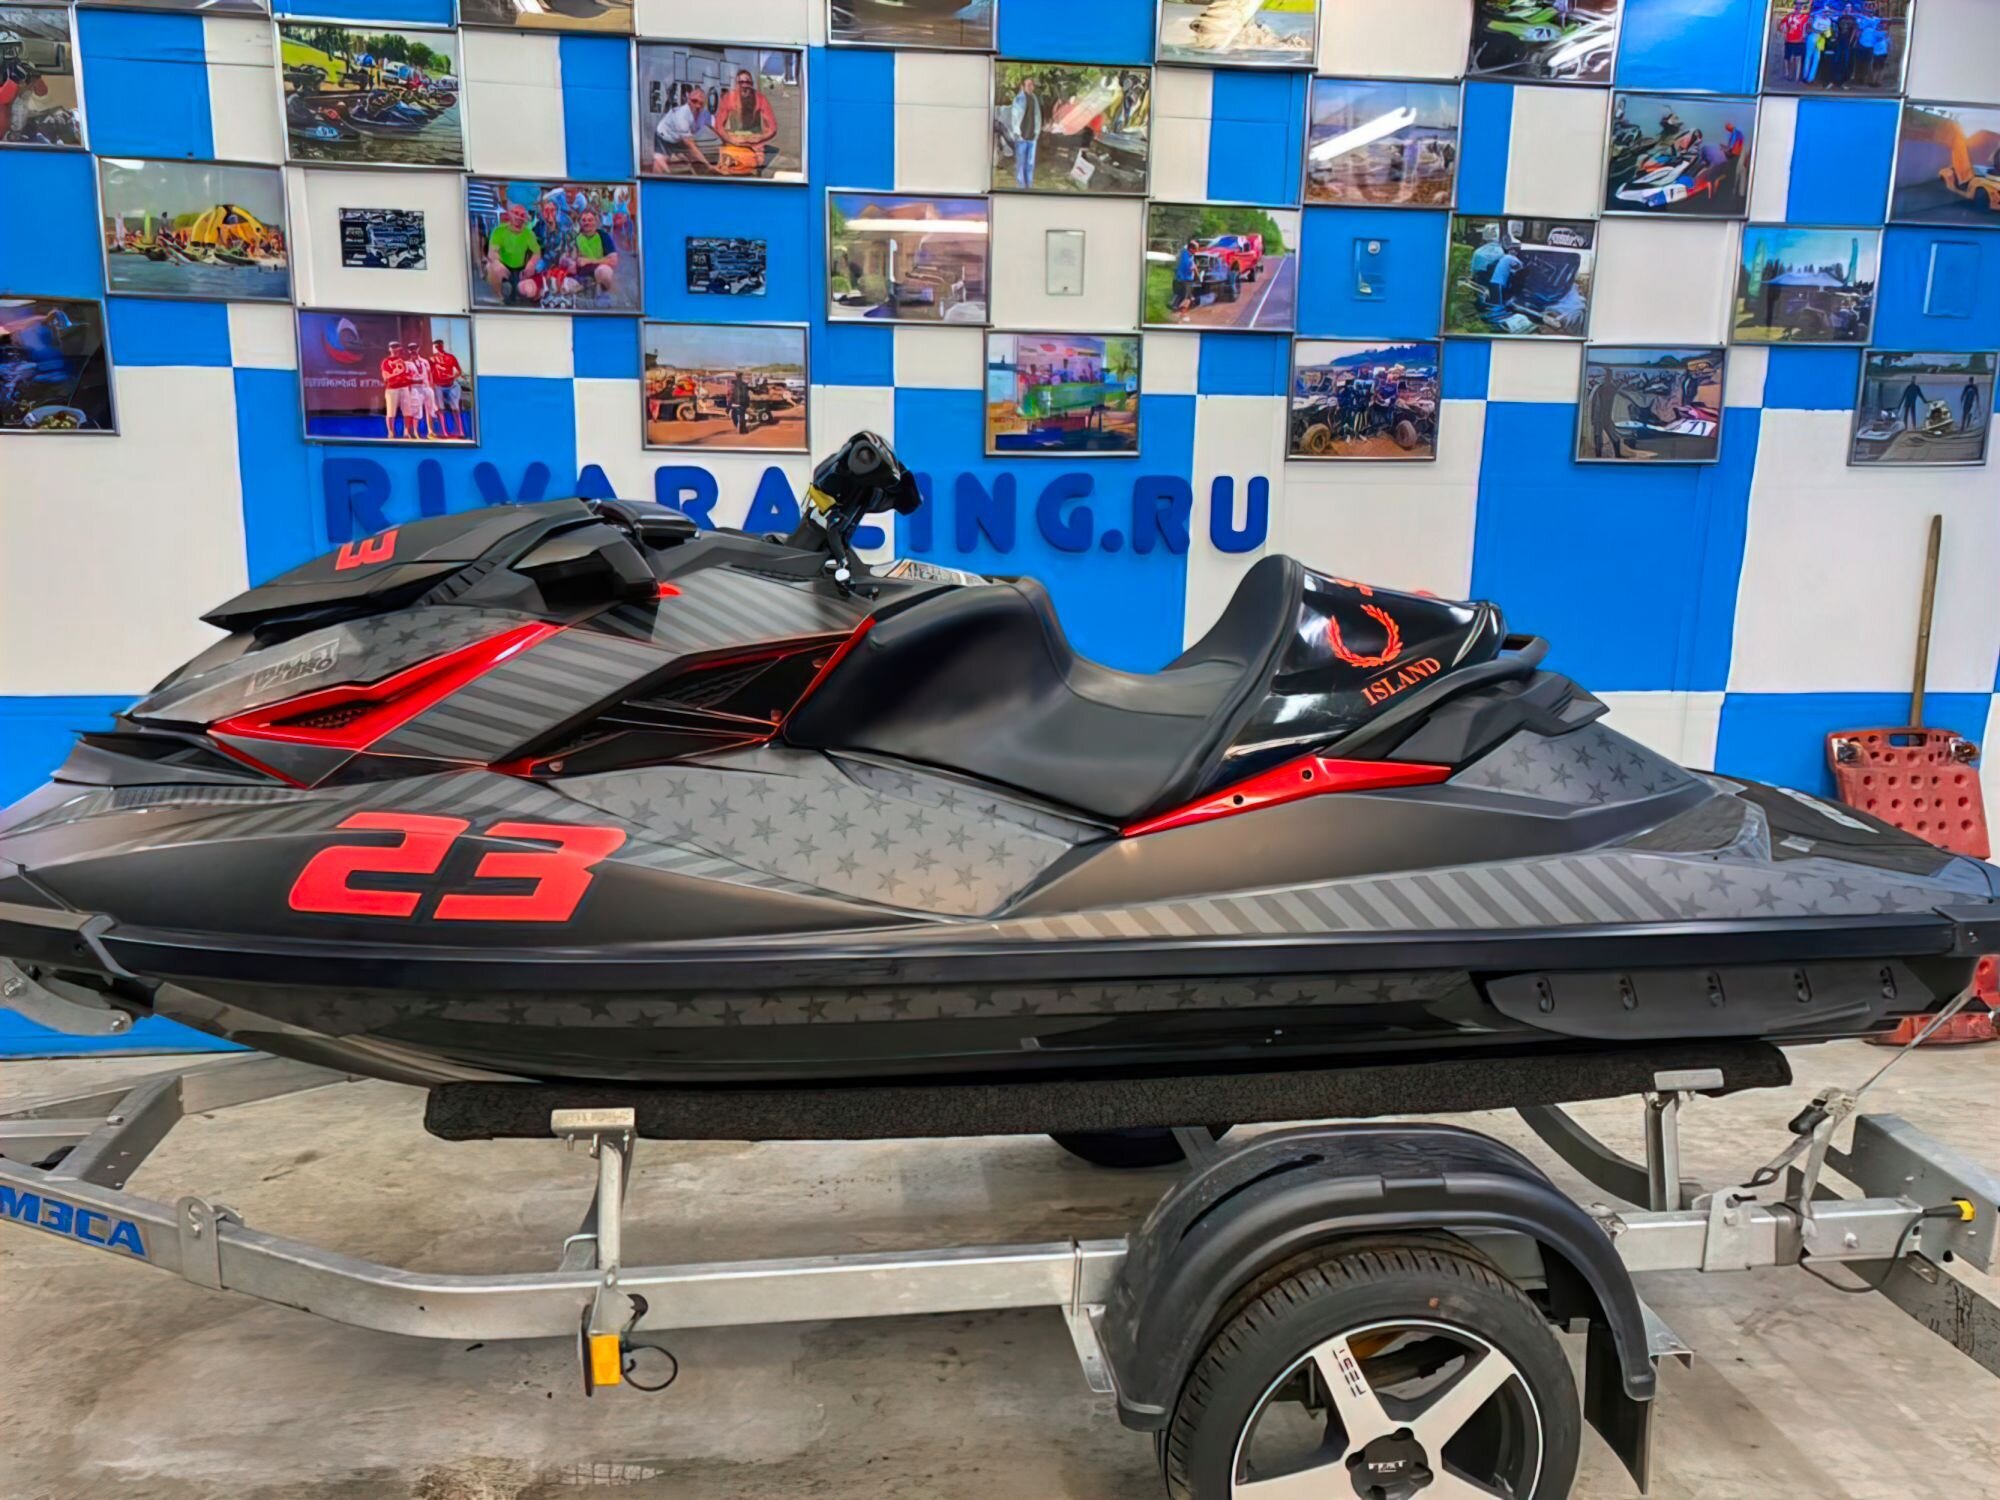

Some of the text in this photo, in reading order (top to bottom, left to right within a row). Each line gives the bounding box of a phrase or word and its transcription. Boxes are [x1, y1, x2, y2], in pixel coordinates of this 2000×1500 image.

[323, 457, 1269, 556] RIVRAING.RU
[1360, 657, 1442, 707] ISLAND
[288, 811, 628, 922] 23
